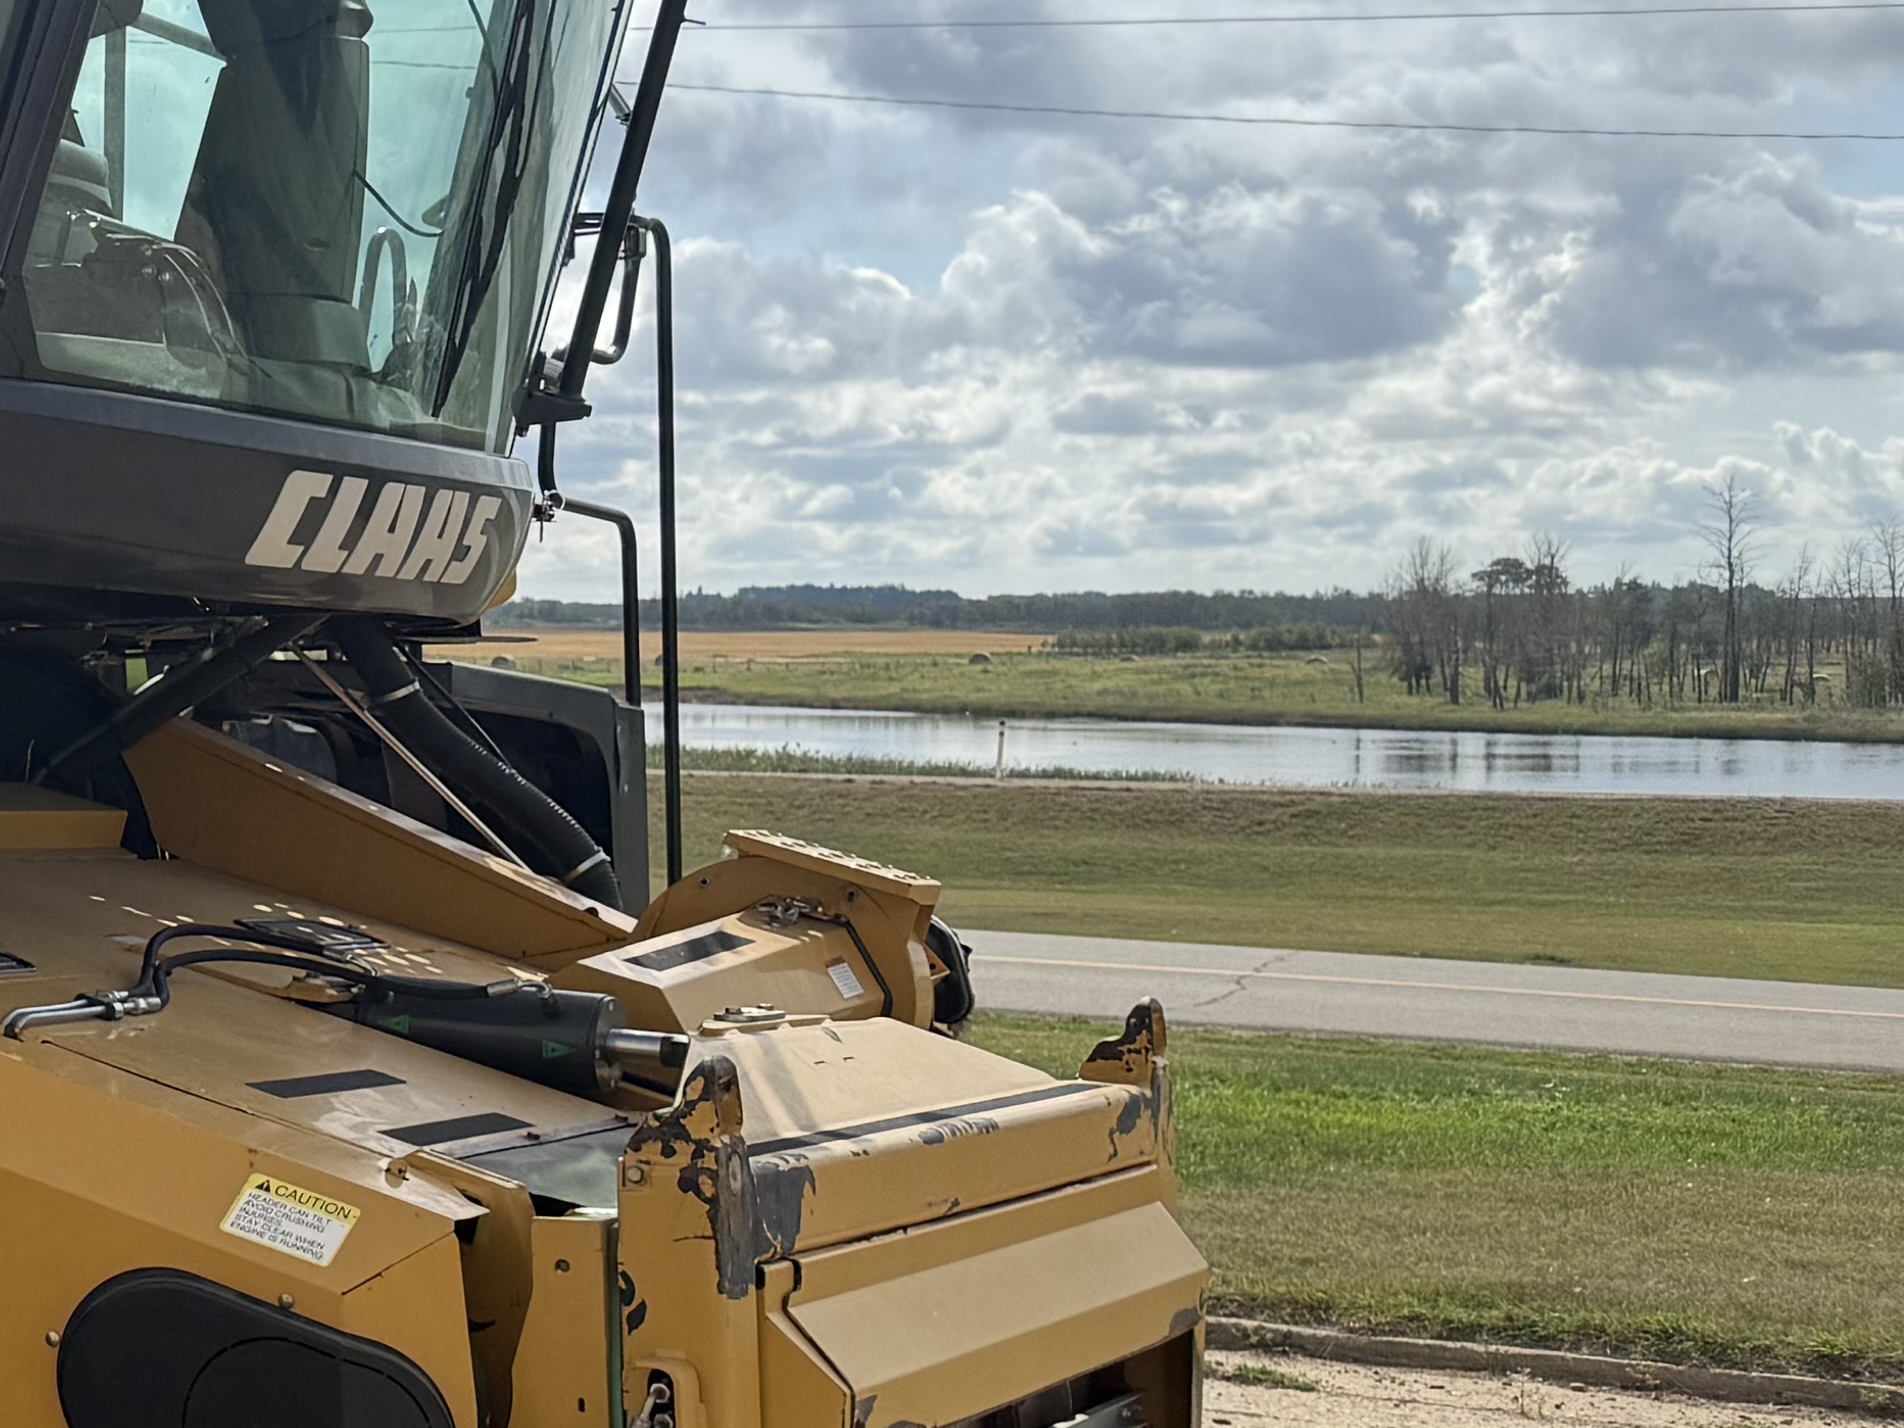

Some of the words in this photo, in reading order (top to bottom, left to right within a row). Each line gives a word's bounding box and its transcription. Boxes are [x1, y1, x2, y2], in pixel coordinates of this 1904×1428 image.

[245, 469, 503, 585] CLAAS
[243, 1199, 274, 1216] AVOID
[274, 1209, 326, 1233] CRUSHING
[247, 1191, 288, 1213] HEADER
[289, 1205, 310, 1220] CAN
[274, 1185, 352, 1219] CAUTION
[229, 1221, 268, 1242] ENGINE
[234, 1213, 260, 1229] STAY
[261, 1222, 294, 1240] CLEAR
[295, 1234, 325, 1250] WHEN
